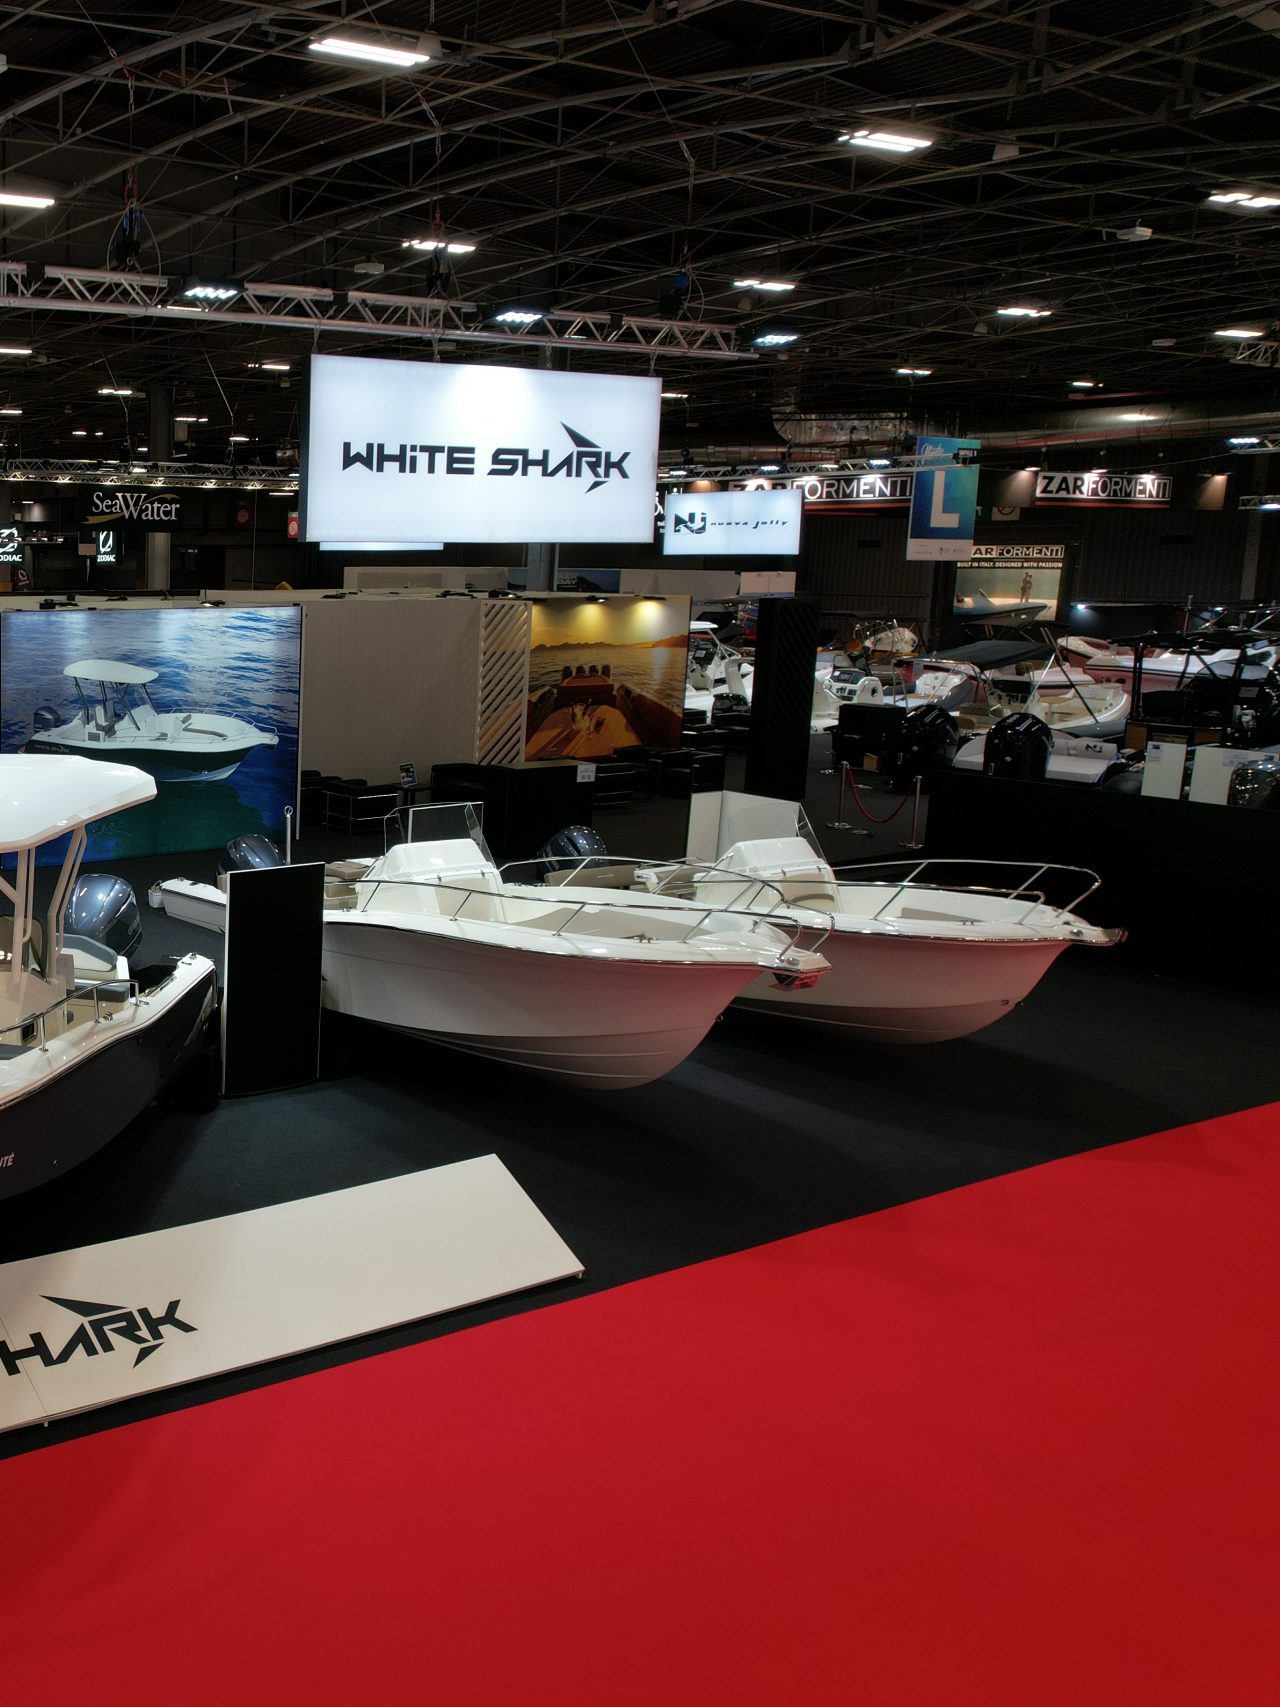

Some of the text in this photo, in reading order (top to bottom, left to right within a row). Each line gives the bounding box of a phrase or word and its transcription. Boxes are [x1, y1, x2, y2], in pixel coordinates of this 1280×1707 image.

[486, 447, 631, 494] SHARK
[930, 468, 960, 528] L
[1040, 474, 1171, 500] ZAR FORMENTI
[92, 491, 180, 520] SeaWater
[97, 554, 116, 563] ZODIAC
[972, 546, 1062, 557] AR FORMENTI
